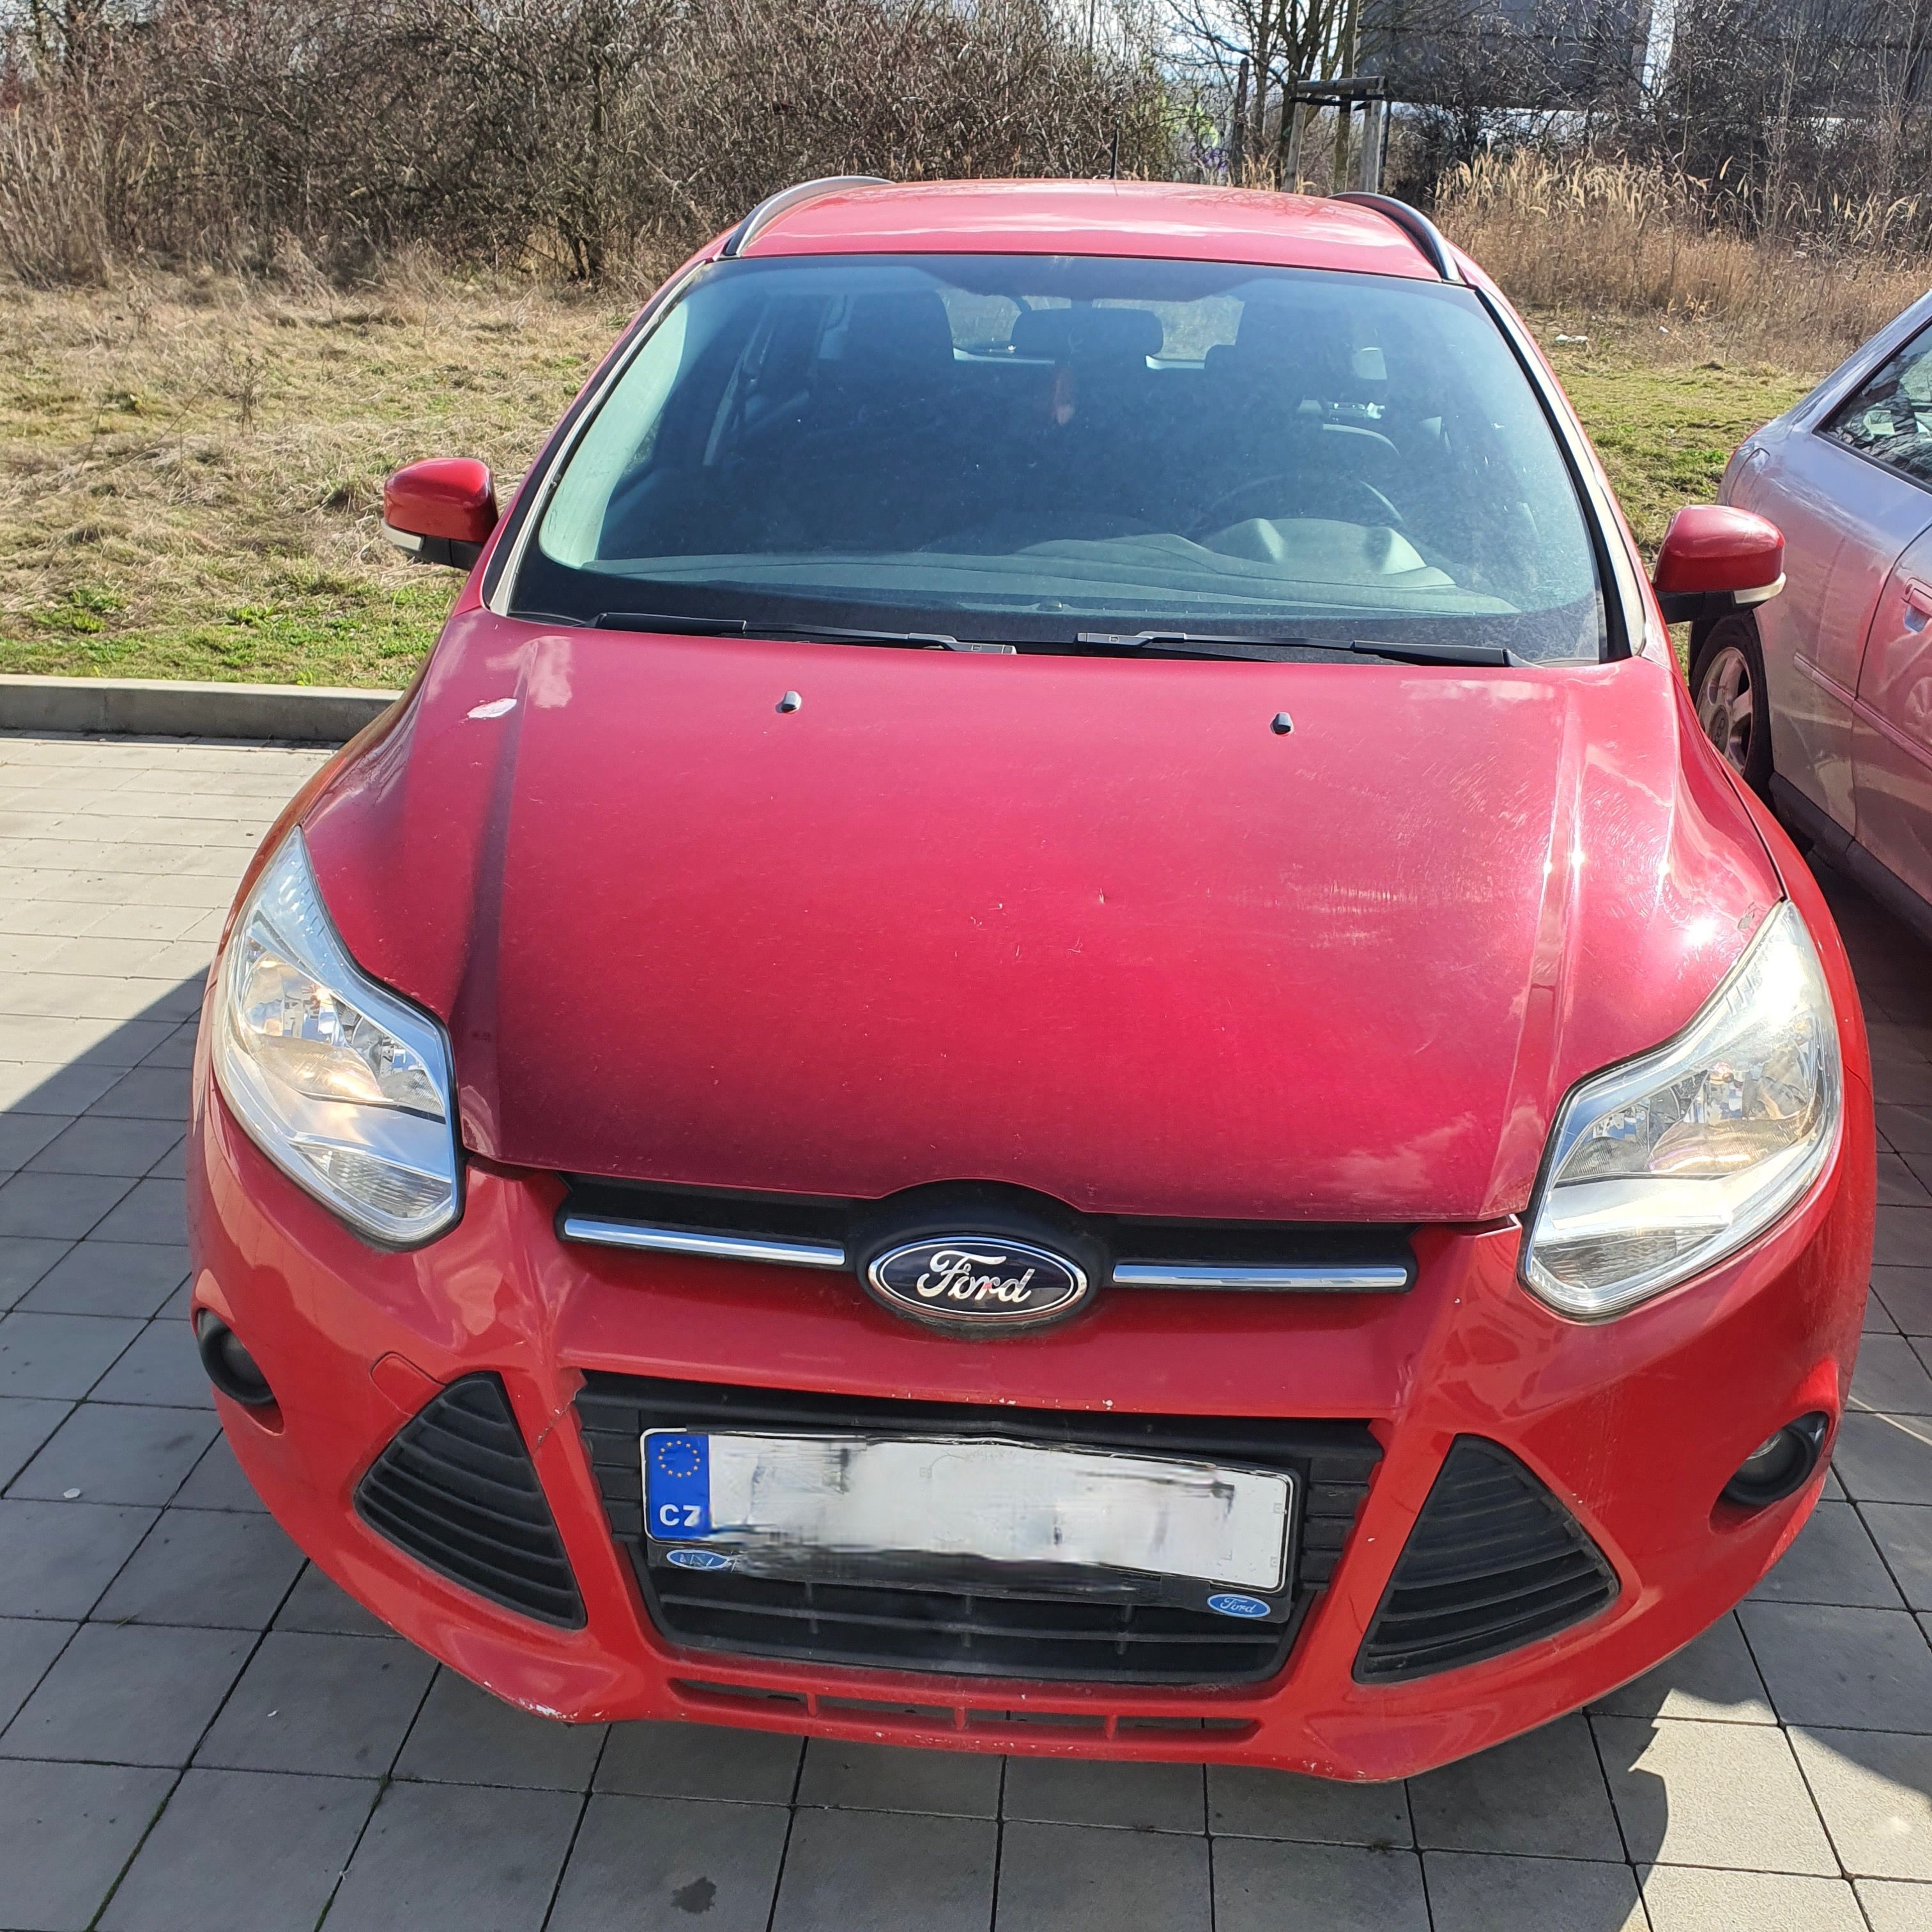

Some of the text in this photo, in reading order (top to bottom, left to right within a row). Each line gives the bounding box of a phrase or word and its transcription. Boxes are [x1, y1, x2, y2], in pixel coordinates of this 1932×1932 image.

[917, 1250, 1035, 1303] Ford
[659, 1504, 701, 1526] CZ
[1220, 1597, 1257, 1613] Ford
